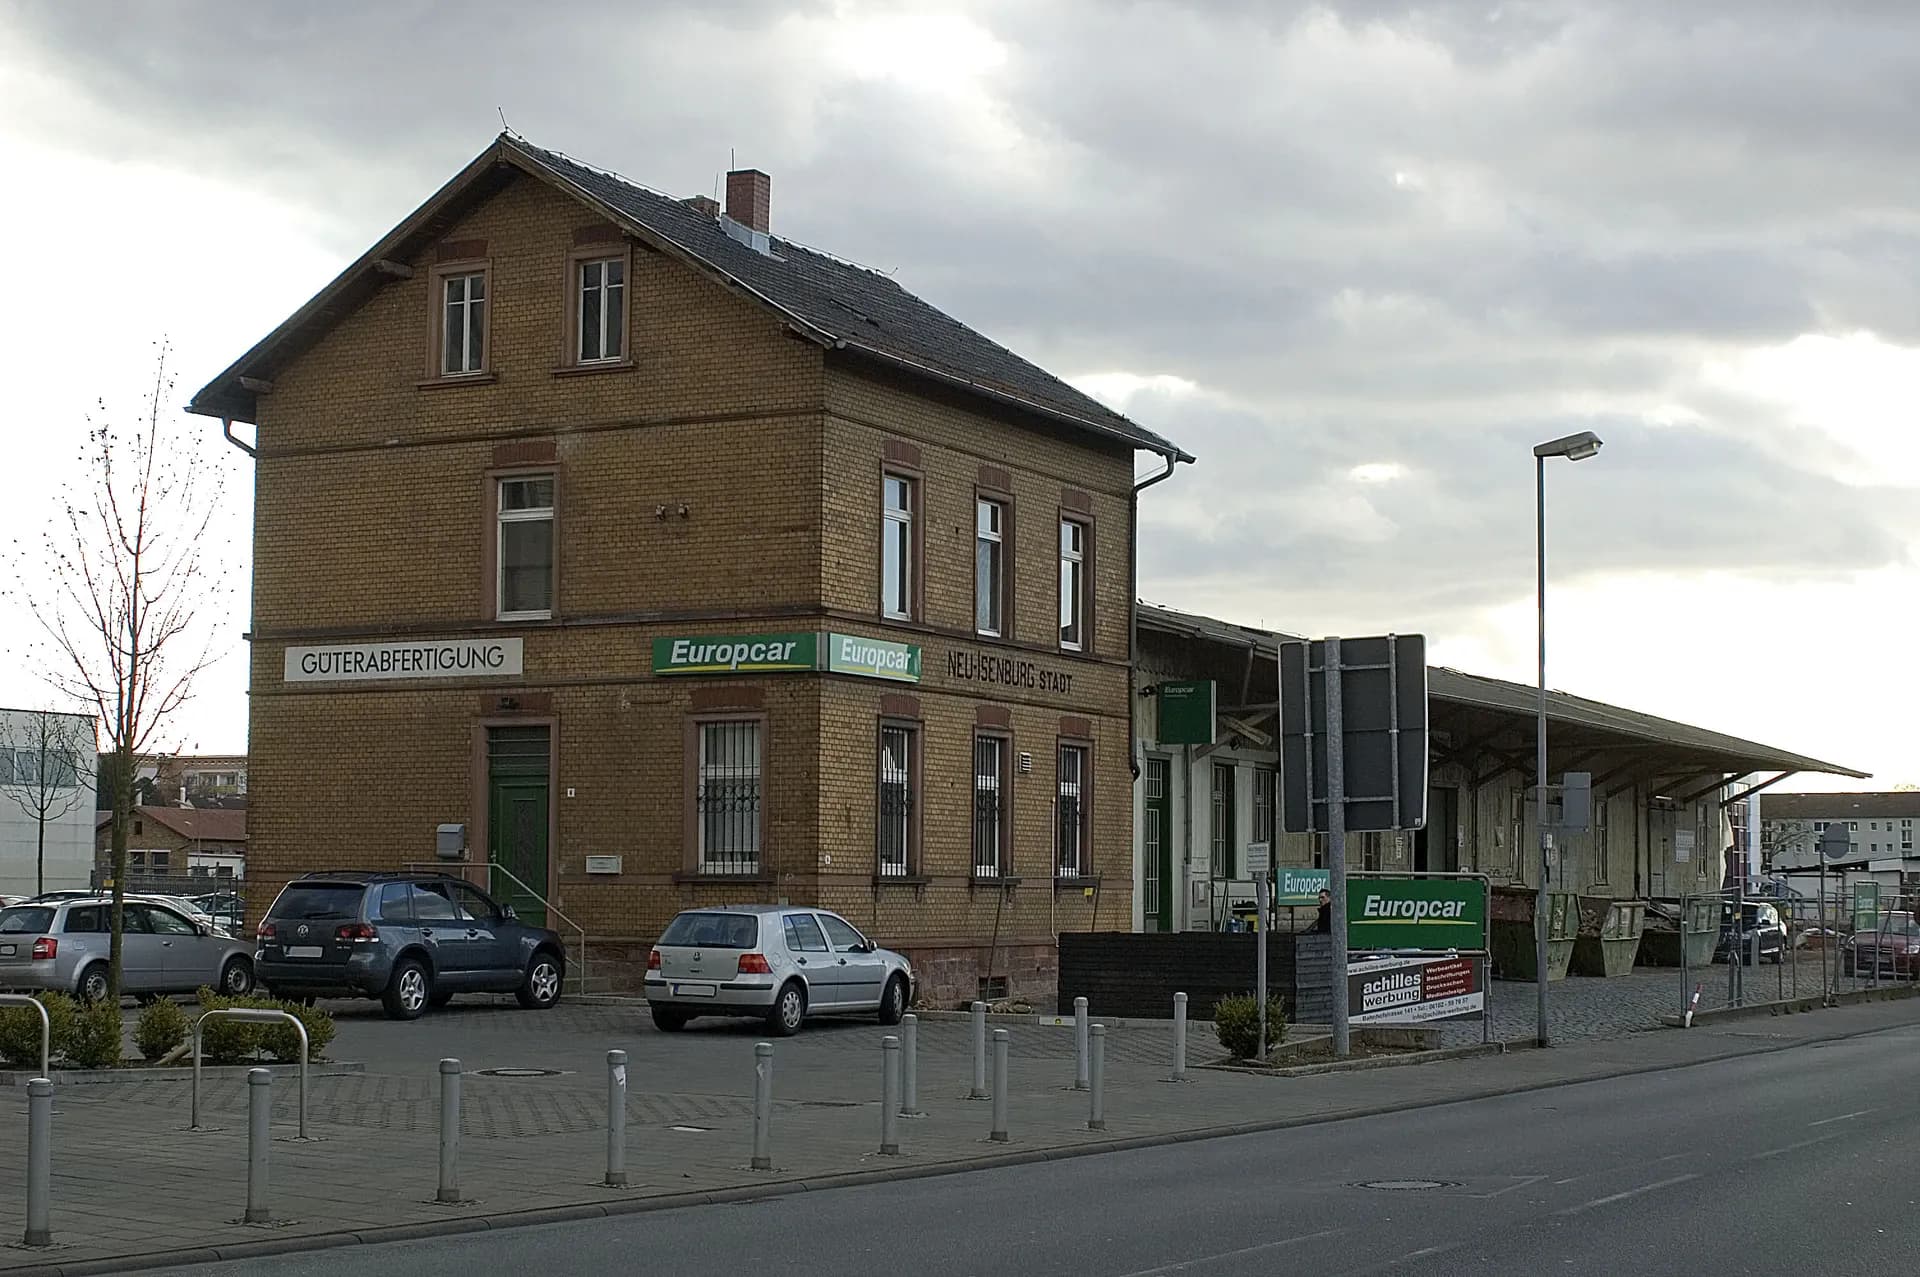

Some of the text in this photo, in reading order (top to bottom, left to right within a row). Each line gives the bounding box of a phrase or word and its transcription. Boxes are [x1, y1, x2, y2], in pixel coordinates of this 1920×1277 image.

[301, 645, 505, 675] GÜTERABFERTIGUNG
[671, 639, 796, 670] Europcar
[841, 638, 912, 674] Europcar
[1039, 670, 1073, 695] STADT
[1284, 872, 1327, 899] Europcar
[1363, 895, 1466, 924] Europcar
[1425, 962, 1463, 974] Werbeartikel
[1363, 973, 1421, 994] achilles
[1426, 979, 1464, 991] Drucksachen
[1364, 989, 1420, 1008] werbung
